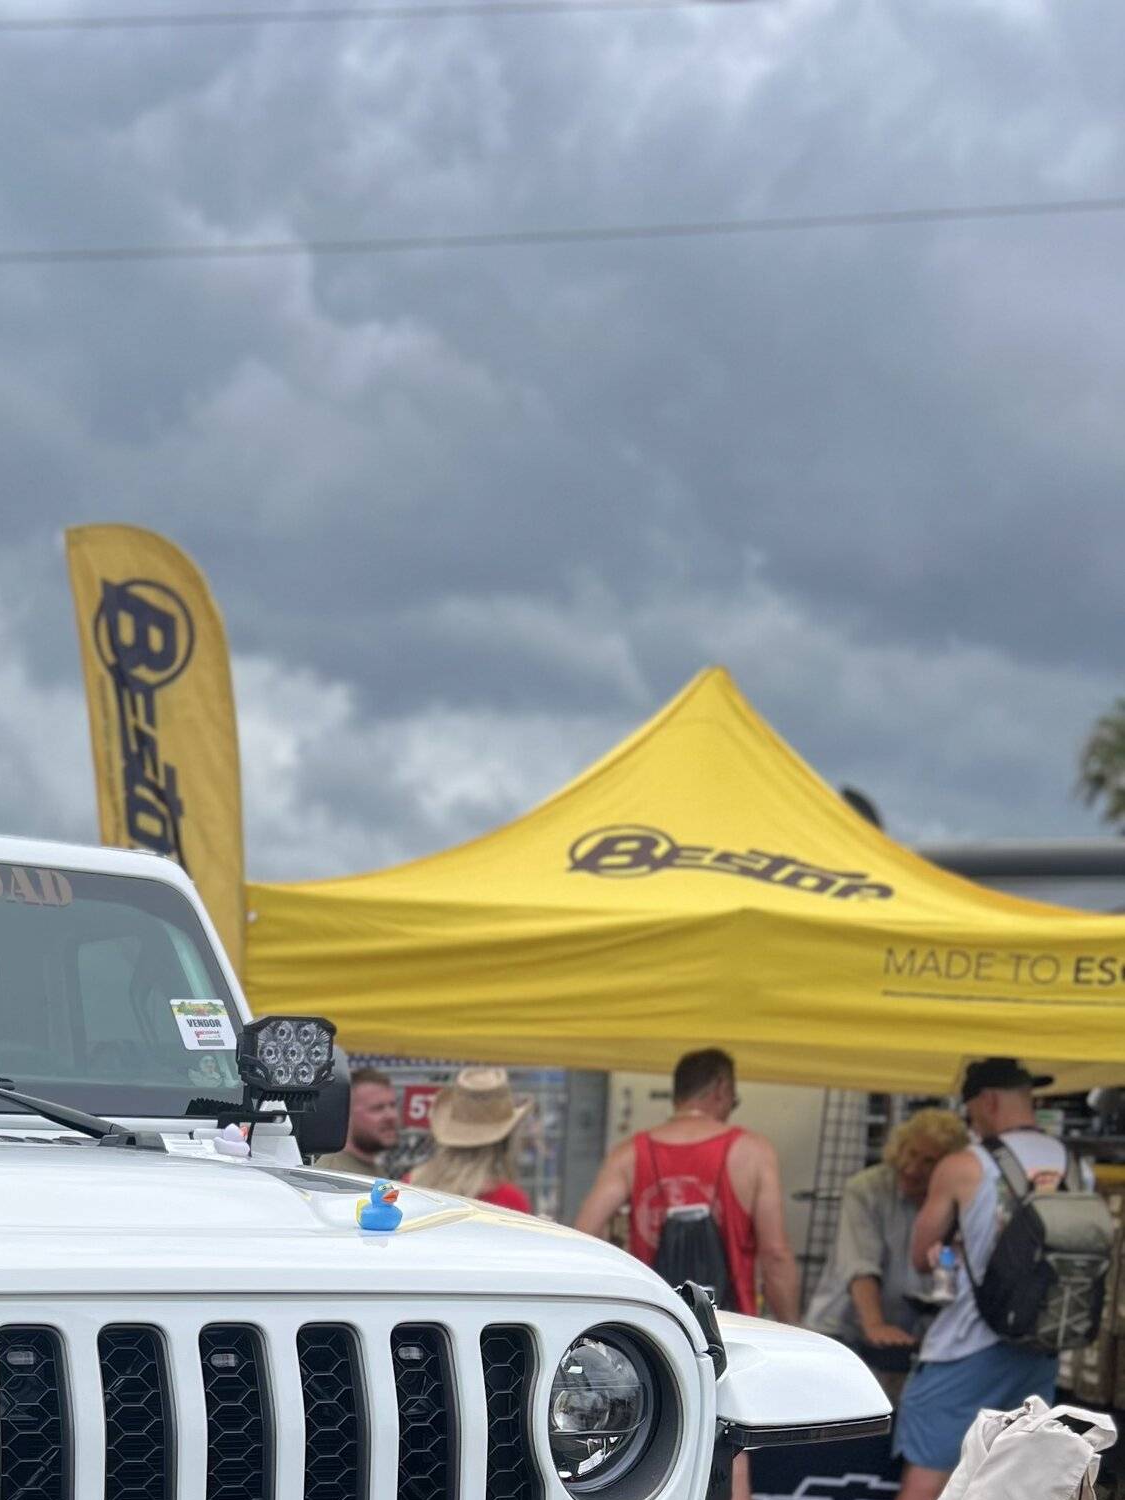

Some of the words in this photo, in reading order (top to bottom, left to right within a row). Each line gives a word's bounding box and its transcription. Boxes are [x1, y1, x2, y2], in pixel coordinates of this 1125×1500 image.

[882, 946, 997, 982] MADE
[1008, 952, 1061, 985] TO
[1073, 955, 1125, 986] ES
[186, 1018, 222, 1028] VENDOR
